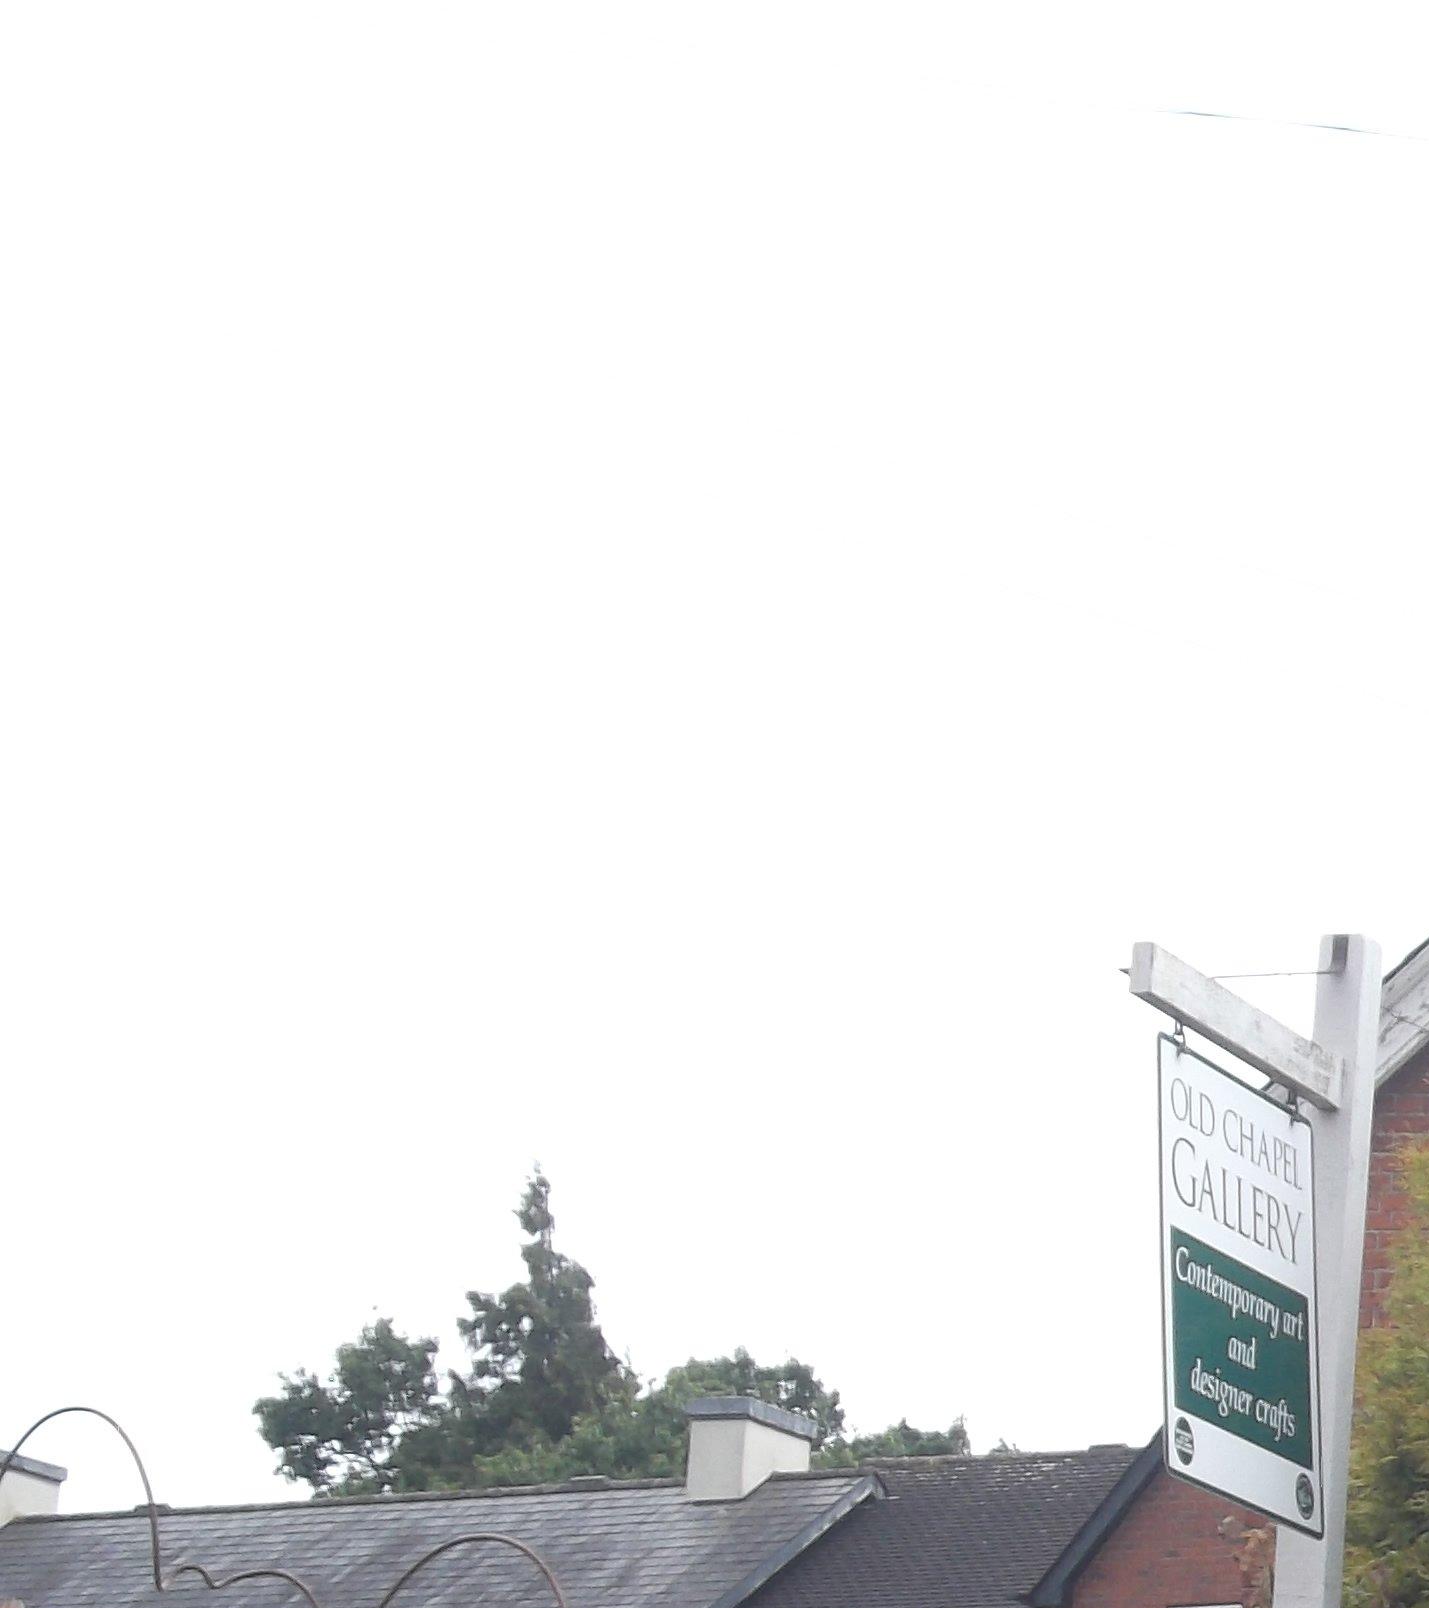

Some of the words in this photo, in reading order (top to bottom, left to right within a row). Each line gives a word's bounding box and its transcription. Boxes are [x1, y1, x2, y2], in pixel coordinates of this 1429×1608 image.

[1170, 1077, 1215, 1137] OLD
[1222, 1108, 1303, 1191] CHAPEL
[1171, 1137, 1303, 1265] GALLERY
[1174, 1246, 1280, 1340] Contemporary
[1282, 1311, 1305, 1342] art
[1190, 1357, 1254, 1418] designer
[1254, 1399, 1297, 1442] crafts
[1227, 1336, 1257, 1371] and
